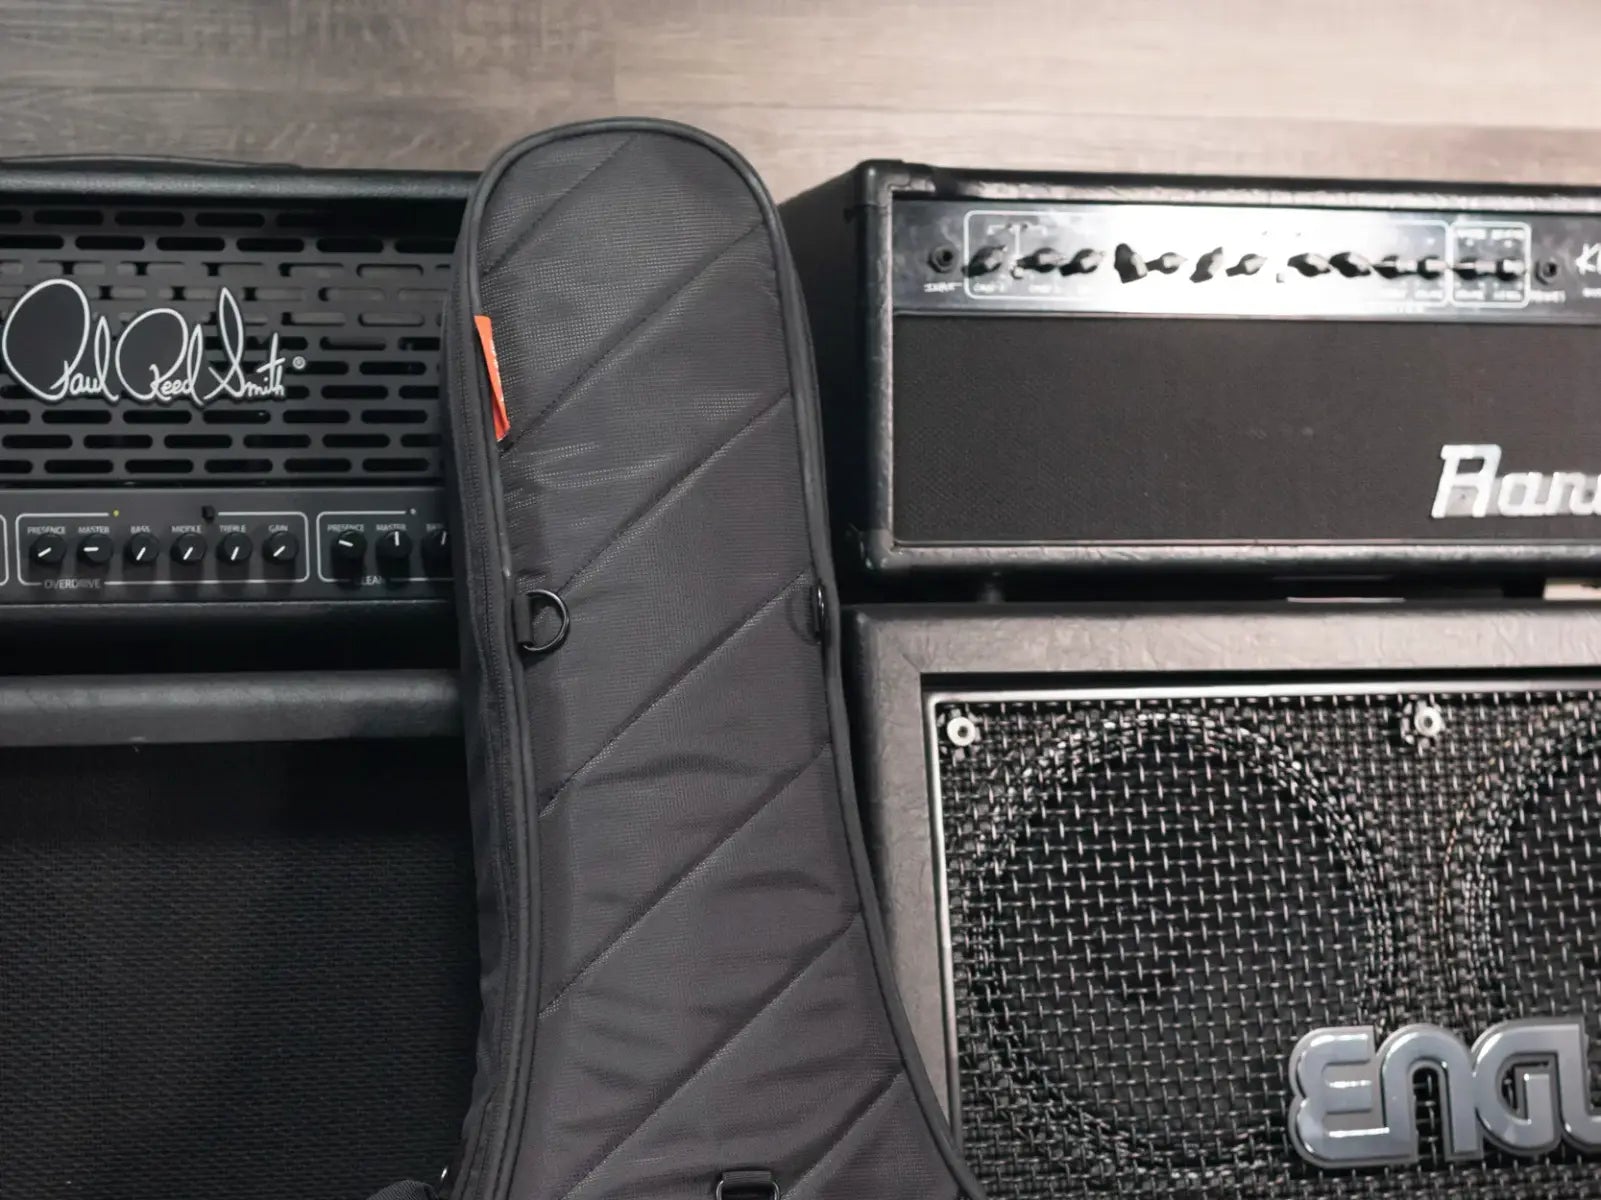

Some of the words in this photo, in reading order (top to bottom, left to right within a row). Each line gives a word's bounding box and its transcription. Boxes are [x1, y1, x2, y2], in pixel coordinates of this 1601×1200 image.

[2, 279, 118, 401] Paul
[115, 308, 204, 405] Reed
[204, 287, 285, 398] Smith
[1431, 444, 1601, 518] Ran
[78, 525, 110, 534] MASTER
[268, 524, 289, 532] GAIN
[44, 578, 102, 589] OVERDRIVE
